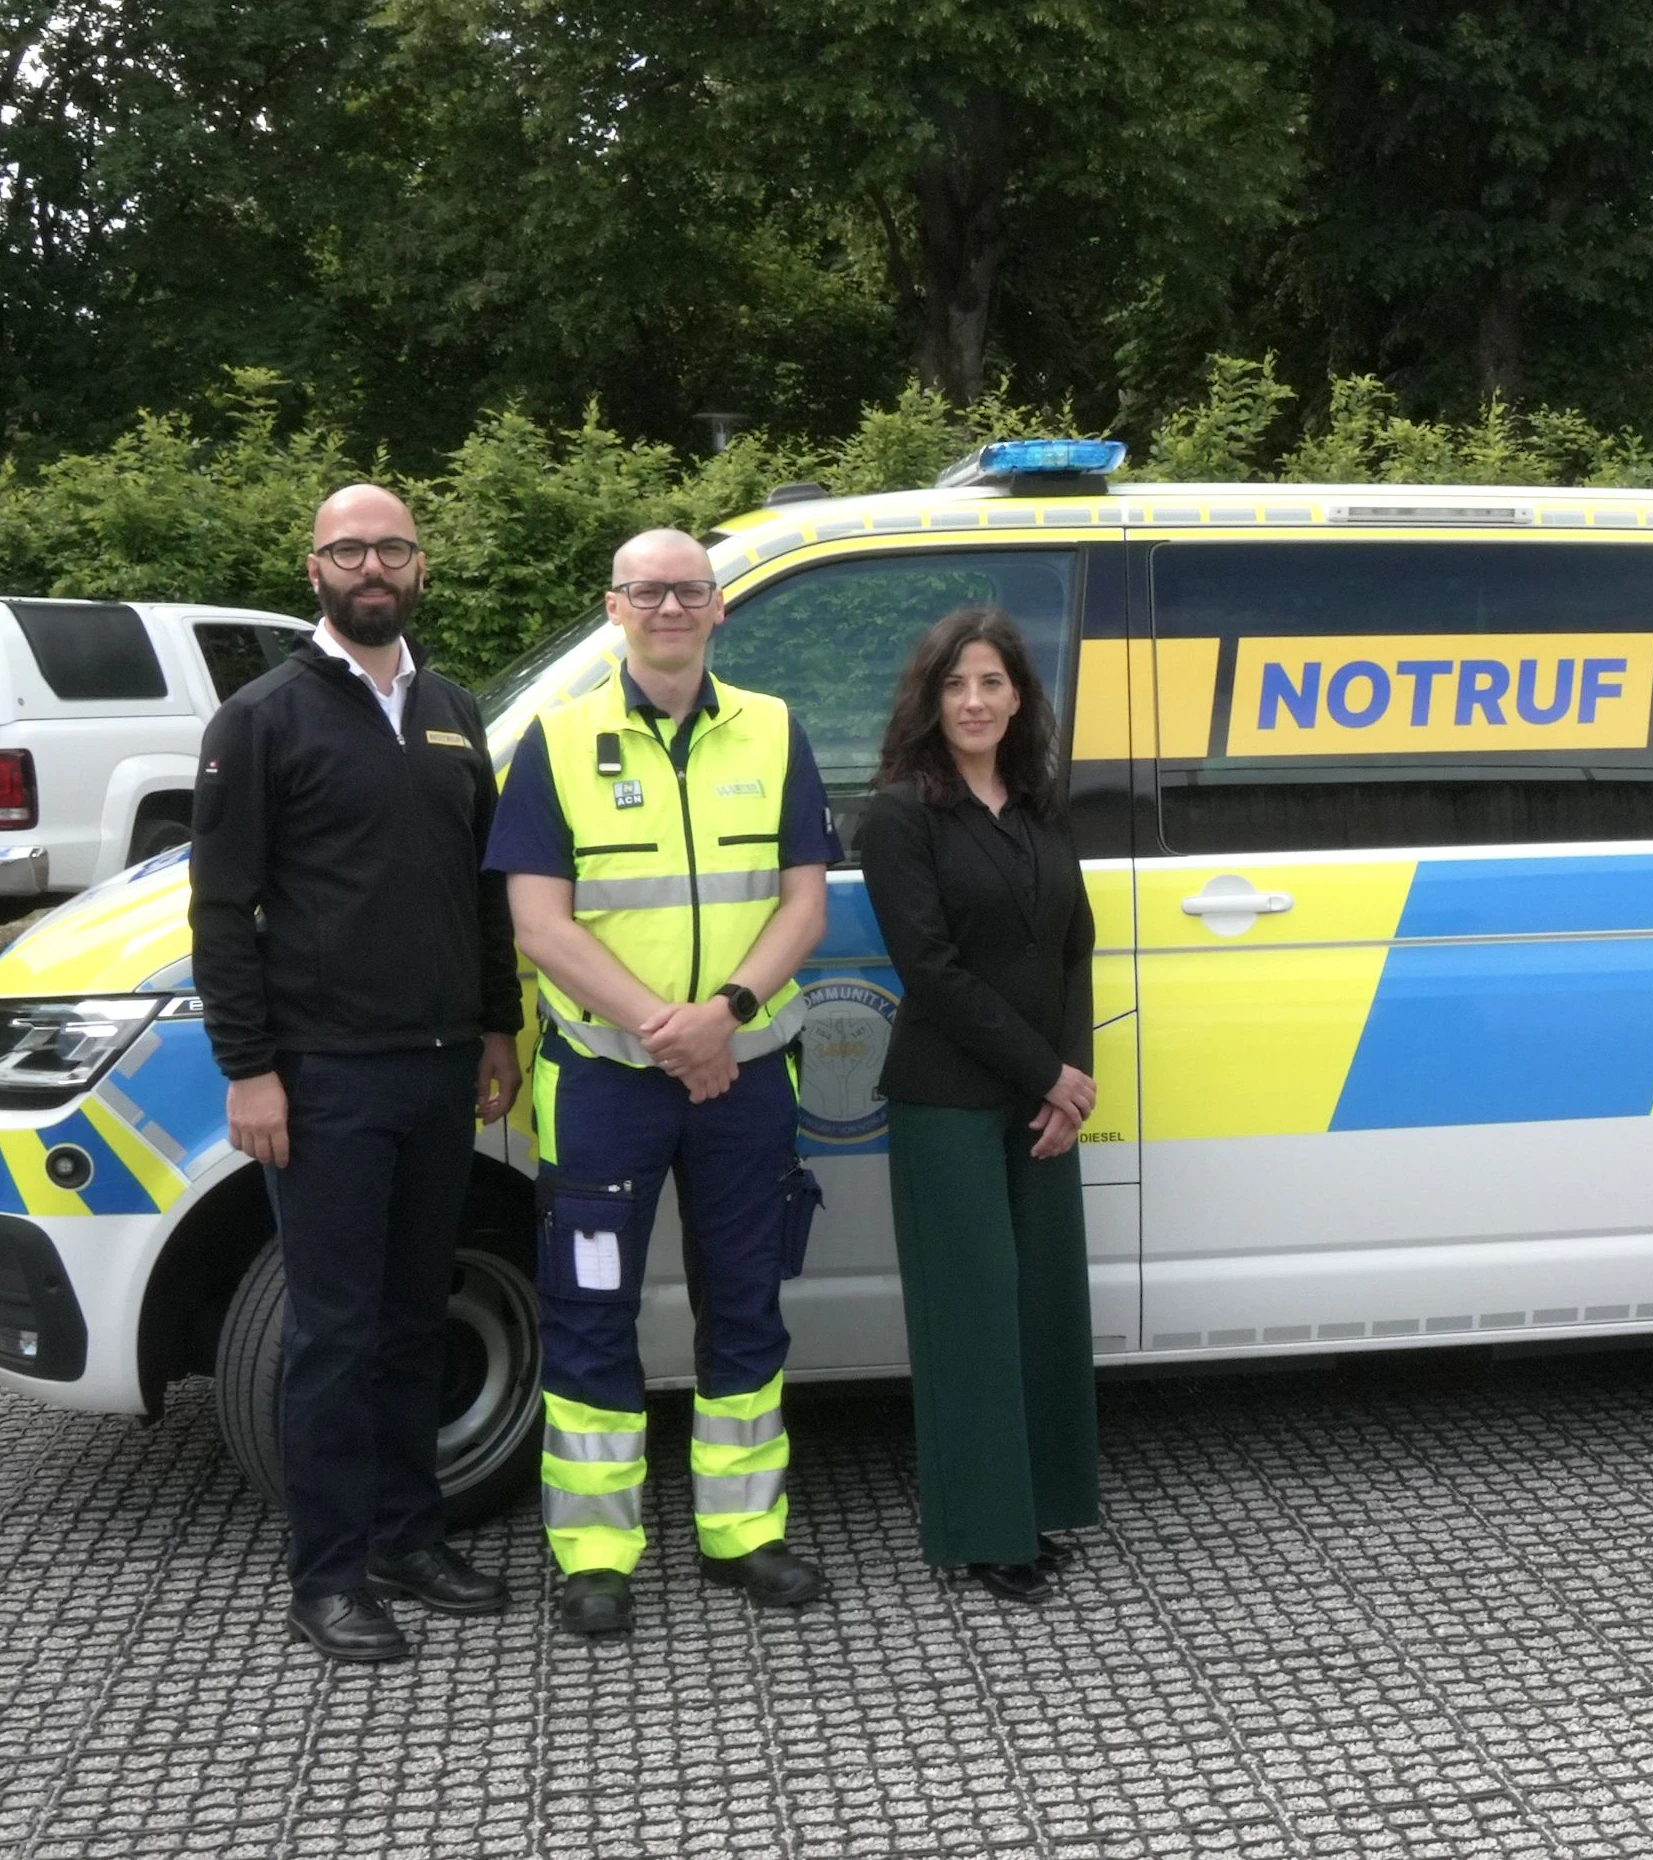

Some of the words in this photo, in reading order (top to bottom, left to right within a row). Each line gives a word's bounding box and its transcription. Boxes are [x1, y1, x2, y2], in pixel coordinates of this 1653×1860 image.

[1257, 658, 1628, 730] NOTRUF
[617, 795, 642, 806] ACN
[803, 986, 890, 1010] OMMUNITY
[1080, 1132, 1124, 1143] DIESEL
